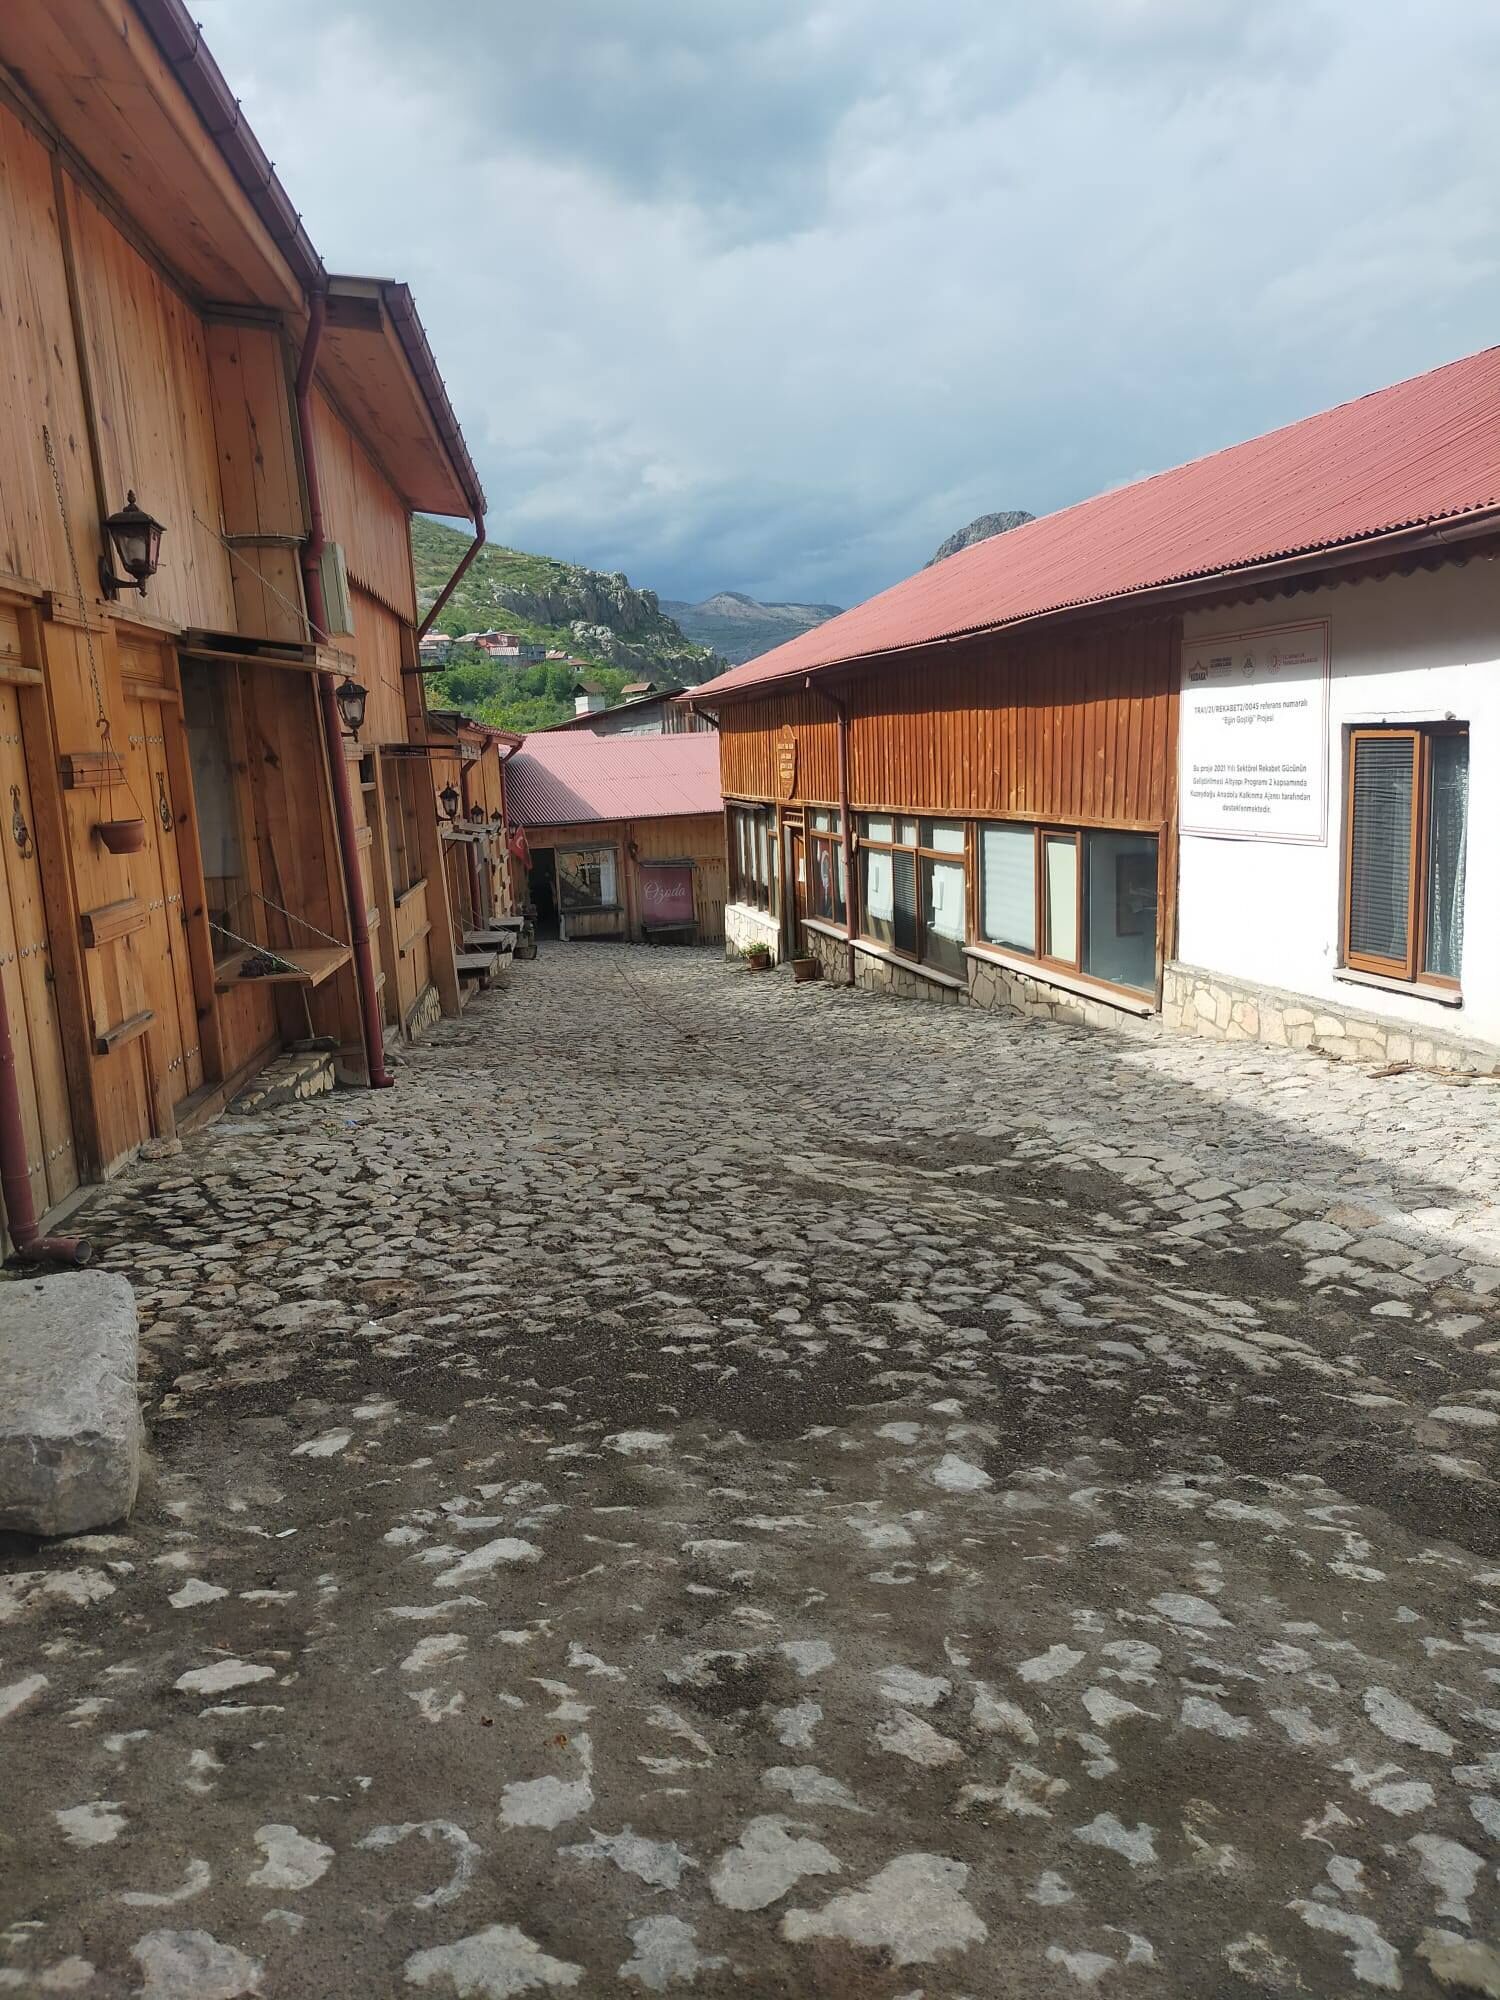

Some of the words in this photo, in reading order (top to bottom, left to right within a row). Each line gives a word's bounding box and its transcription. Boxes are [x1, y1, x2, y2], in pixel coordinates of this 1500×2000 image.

[1260, 700, 1281, 710] referans
[1192, 764, 1199, 772] Bu
[1200, 766, 1213, 774] proje
[1214, 764, 1226, 772] 2021
[1236, 764, 1257, 772] Sektörel
[1258, 764, 1280, 772] Rekabet
[1281, 764, 1307, 773] Gücünün
[1192, 777, 1224, 786] Geliştirilmesi
[1224, 778, 1243, 787] Altyapı
[1244, 778, 1267, 787] Programı
[1273, 778, 1308, 788] kapsamında
[1190, 790, 1216, 800] Kuzeydoğu
[1217, 791, 1238, 799] Anadolu
[1239, 791, 1263, 800] Kalkınma
[1264, 792, 1281, 801] Ajansı
[1281, 792, 1311, 801] tarafından
[1222, 804, 1272, 813] desteklenmektedir.
